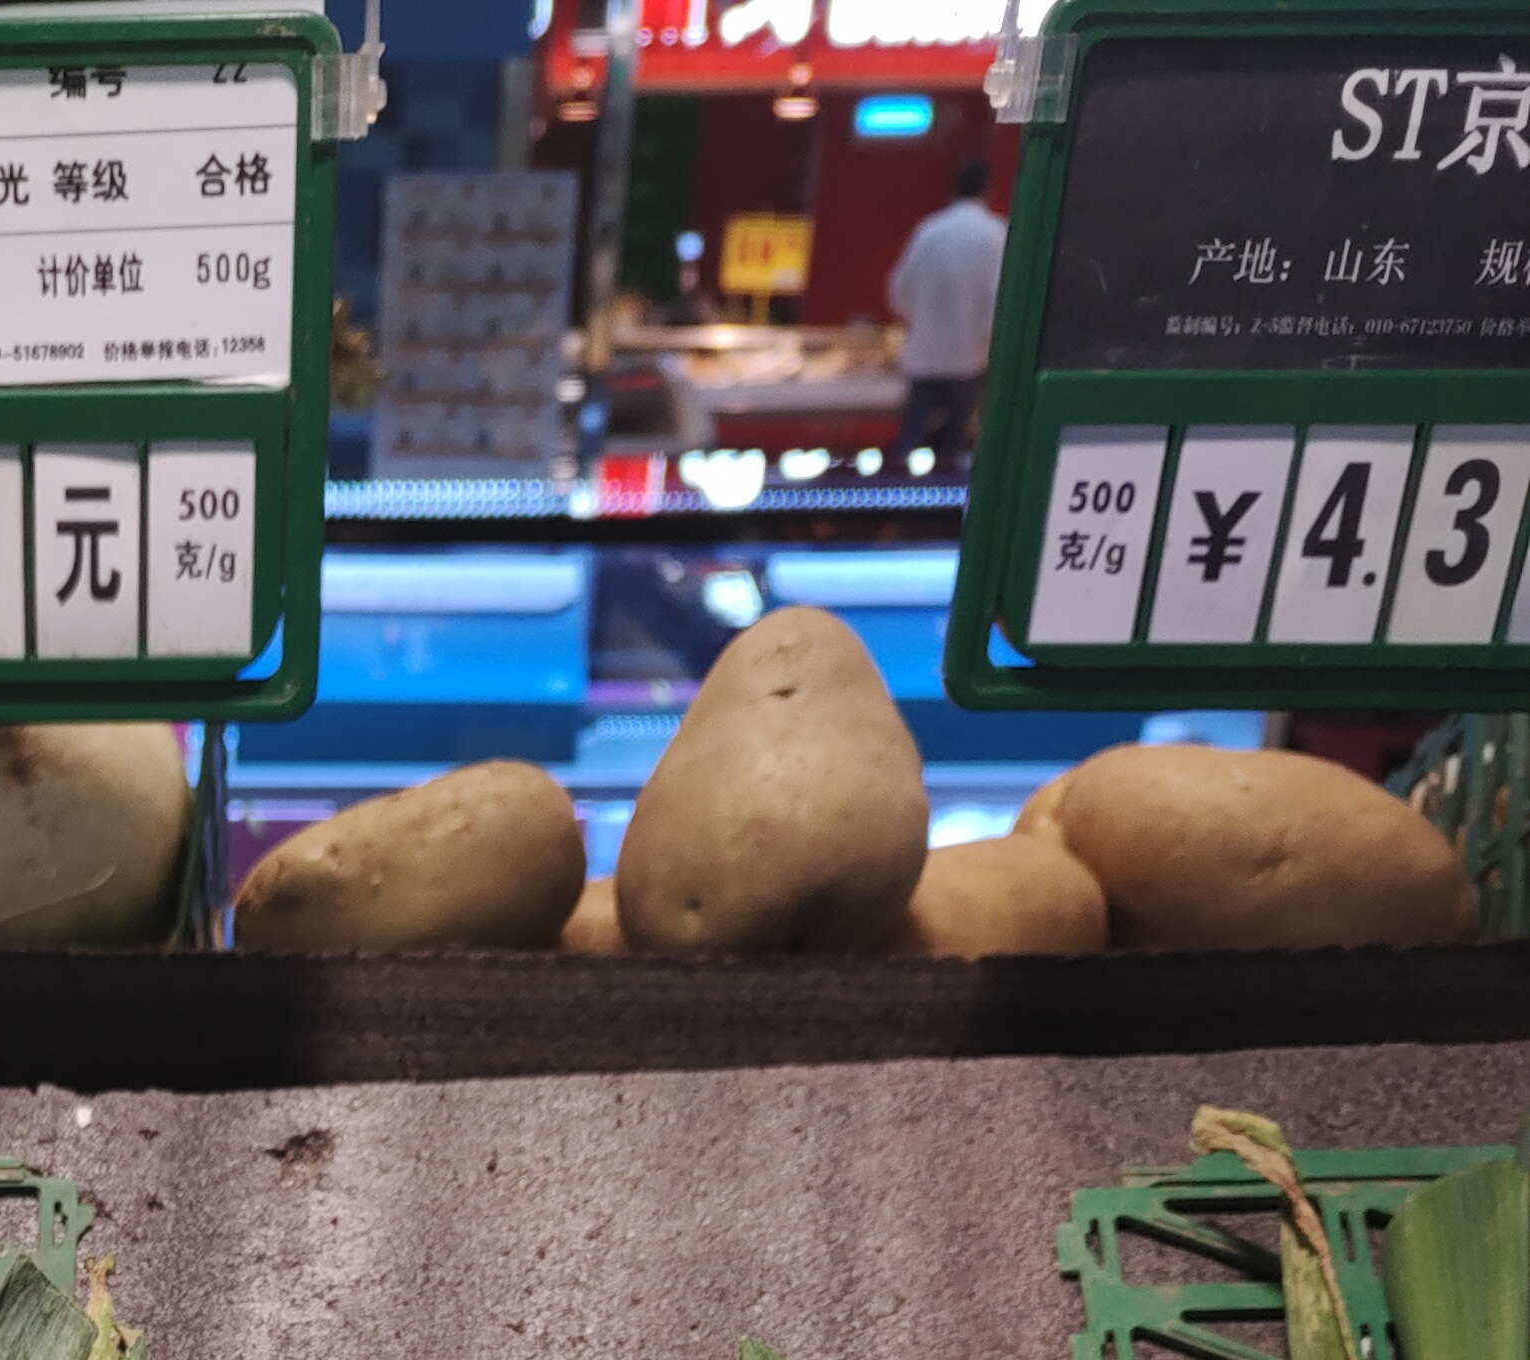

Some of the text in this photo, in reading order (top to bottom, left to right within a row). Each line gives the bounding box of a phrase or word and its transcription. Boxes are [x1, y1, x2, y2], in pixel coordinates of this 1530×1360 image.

[48, 66, 128, 99] 编号
[53, 159, 130, 204] 等级
[195, 152, 273, 198] 合格
[37, 252, 144, 299] 计价单位
[196, 252, 272, 291] 500g
[1473, 237, 1530, 287] 规
[178, 488, 241, 523] 500
[1067, 480, 1137, 515] 500
[175, 540, 238, 585] 克/g
[1054, 531, 1128, 575] 克/g
